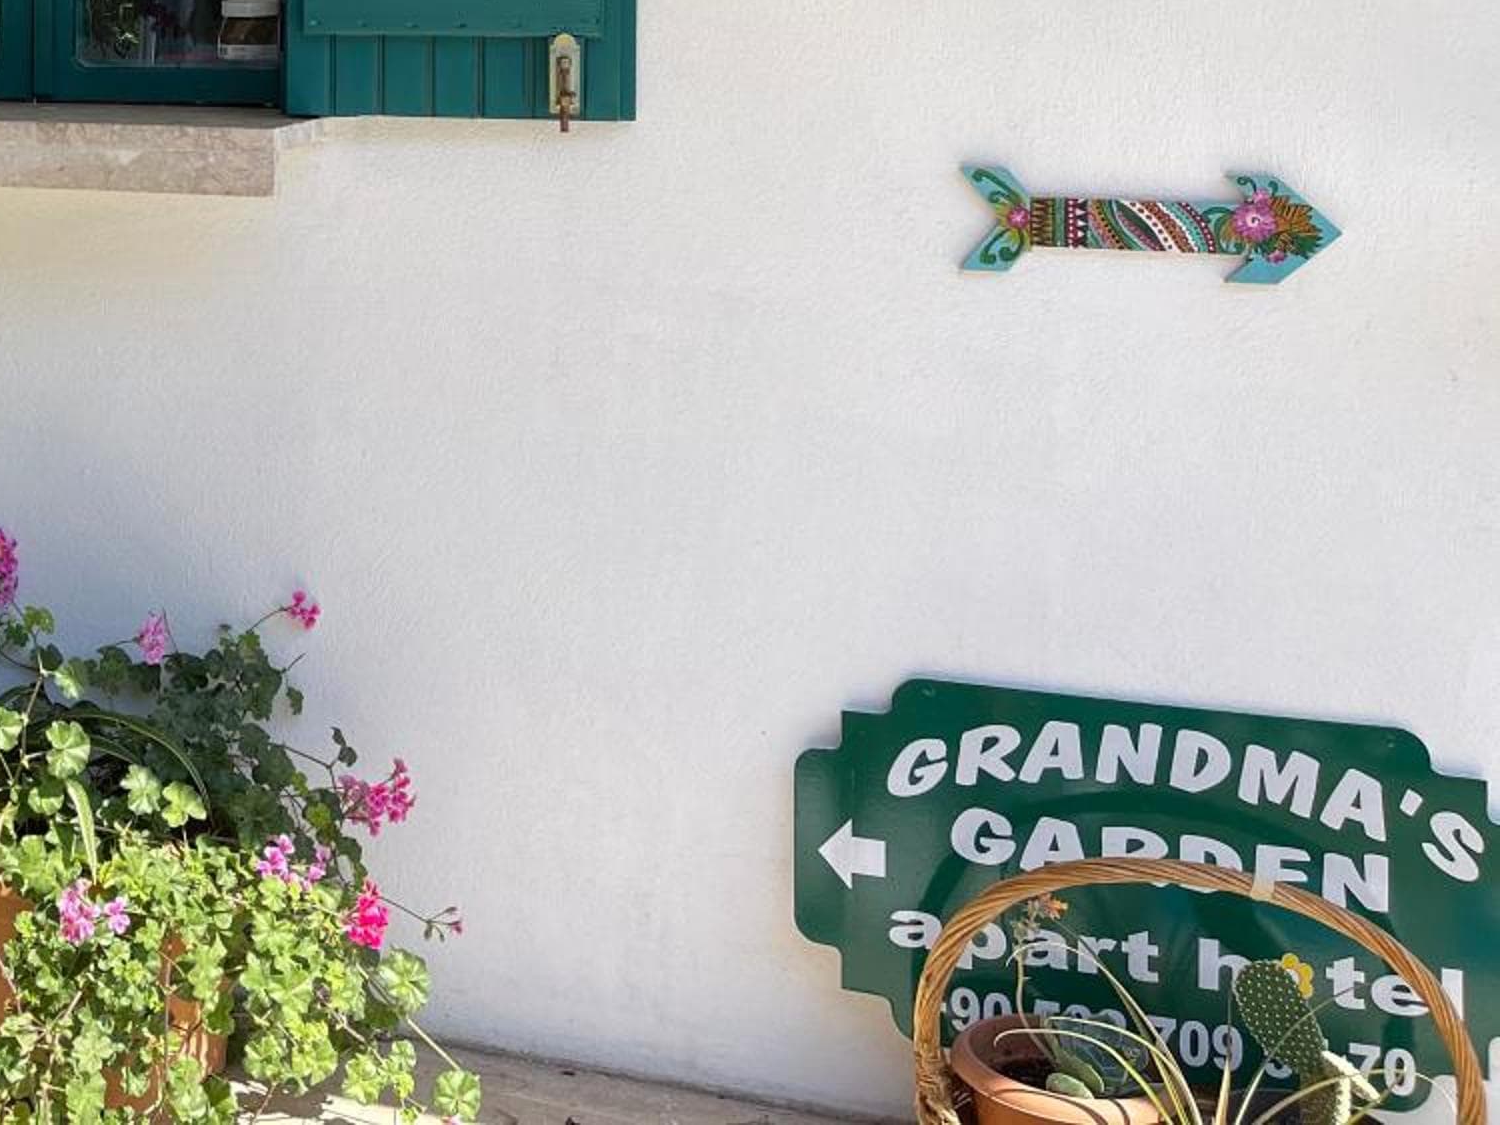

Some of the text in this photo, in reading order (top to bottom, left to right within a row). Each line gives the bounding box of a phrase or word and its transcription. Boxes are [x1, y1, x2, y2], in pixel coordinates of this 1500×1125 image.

[886, 720, 1485, 882] GRANDMA'S
[889, 909, 1464, 1021] apart htel
